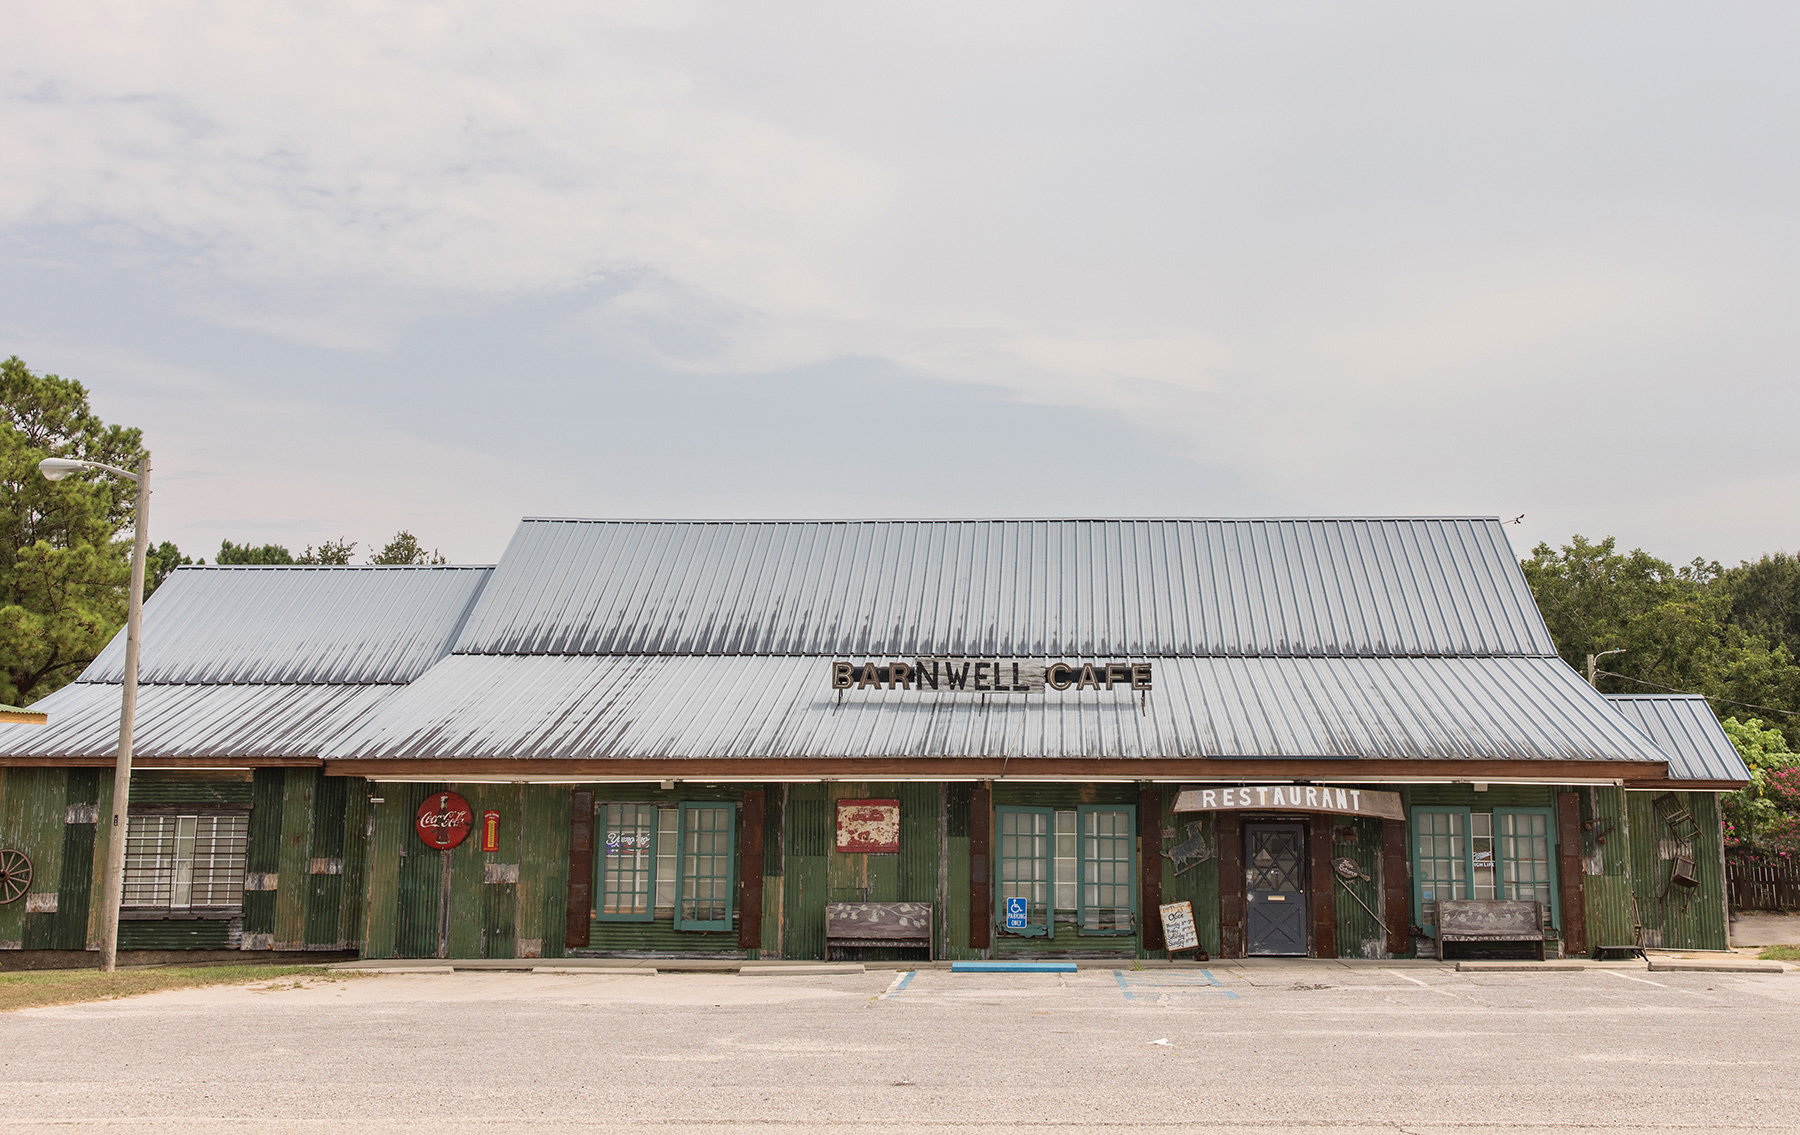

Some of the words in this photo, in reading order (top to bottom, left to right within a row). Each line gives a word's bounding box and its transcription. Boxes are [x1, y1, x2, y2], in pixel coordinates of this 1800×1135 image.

[832, 661, 1030, 691] BARNWELL
[1047, 661, 1152, 691] CAFE
[1202, 786, 1361, 811] RESTAURANT
